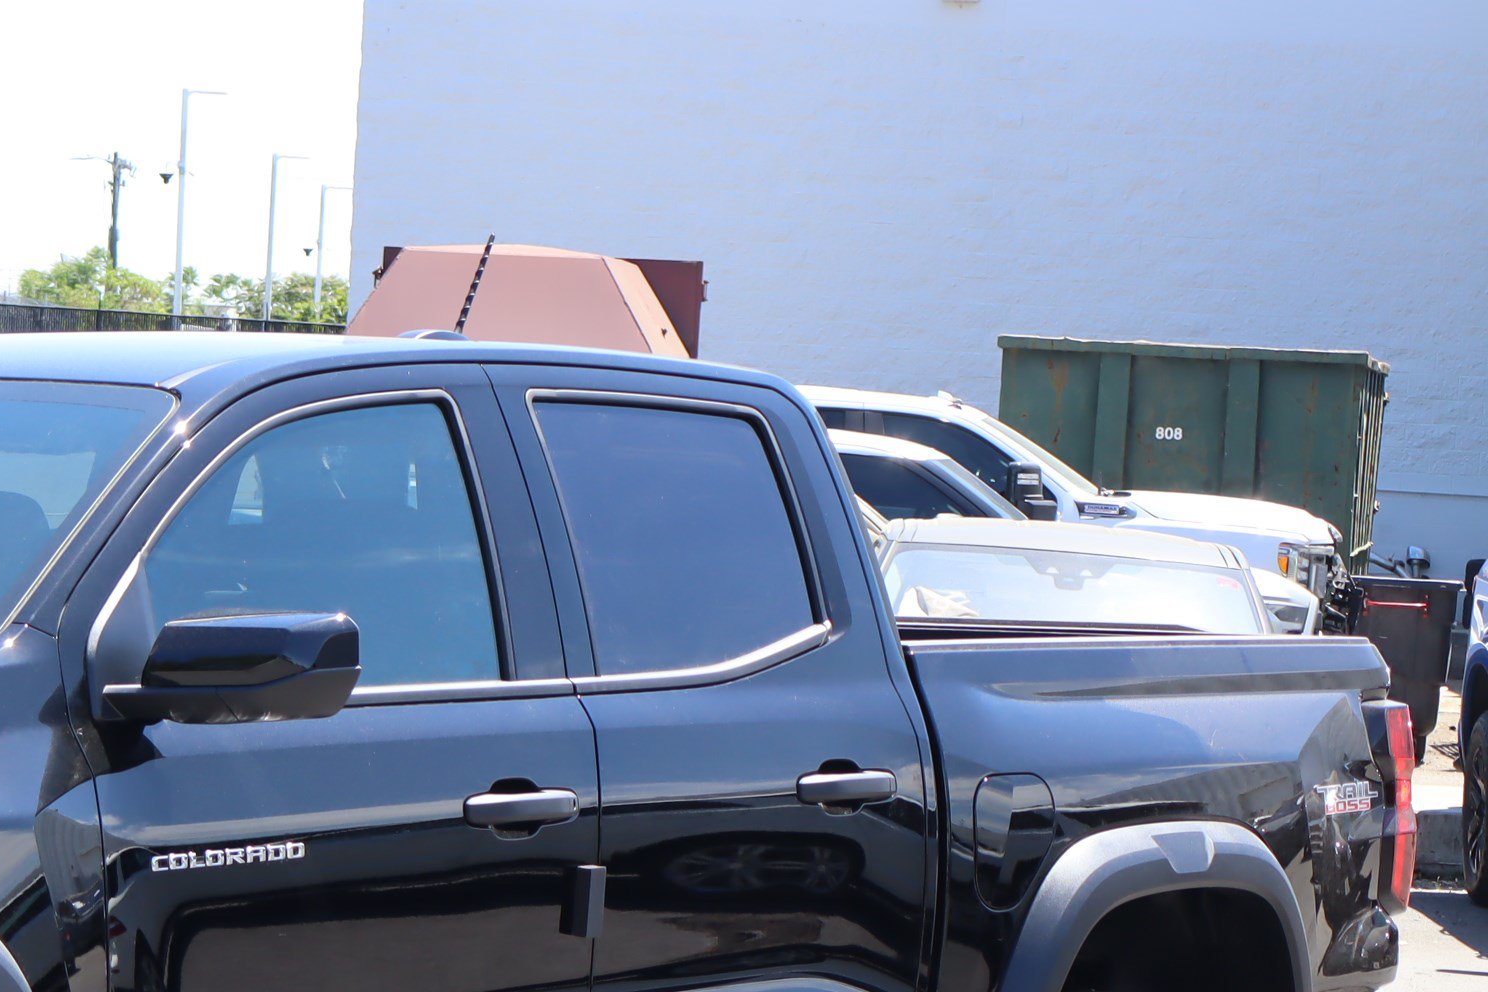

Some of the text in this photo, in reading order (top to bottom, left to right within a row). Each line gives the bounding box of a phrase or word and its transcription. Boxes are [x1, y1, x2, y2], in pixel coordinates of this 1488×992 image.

[1155, 426, 1183, 440] 808
[1314, 781, 1378, 801] TRAIL
[151, 841, 305, 872] COLORADO
